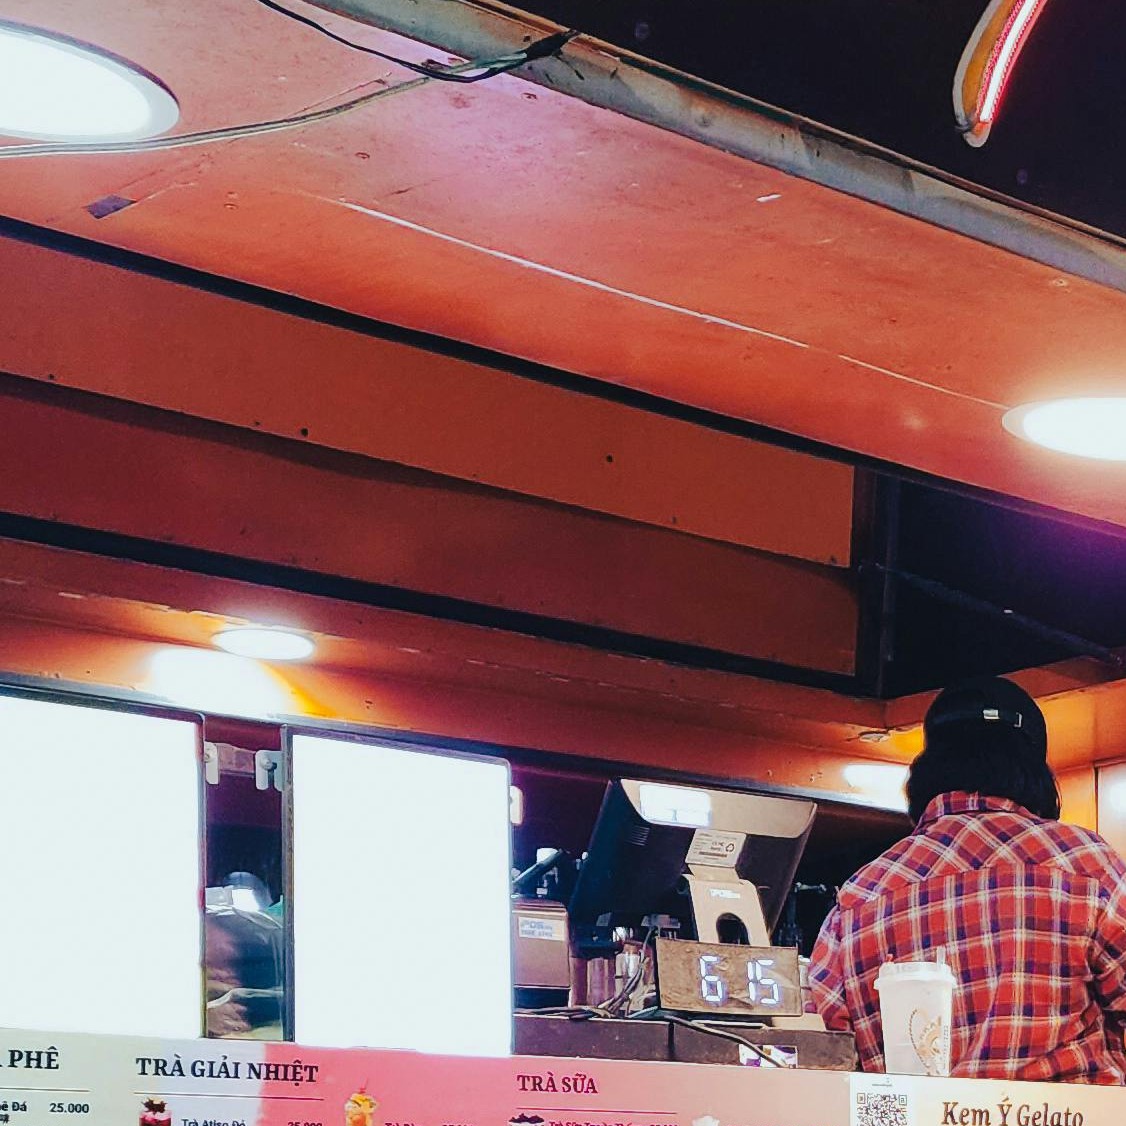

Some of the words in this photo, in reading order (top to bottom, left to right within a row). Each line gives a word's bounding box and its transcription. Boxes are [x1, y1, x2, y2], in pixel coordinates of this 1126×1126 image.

[8, 1046, 60, 1069] PHÊ
[136, 1053, 186, 1076] TRÀ
[190, 1055, 241, 1079] GIẢI
[247, 1059, 319, 1086] NHIỆT
[517, 1071, 558, 1092] TRÀ
[561, 1073, 598, 1093] SỮA
[12, 1101, 27, 1112] Đá
[49, 1103, 89, 1113] 25.000
[941, 1102, 991, 1126] Kem
[997, 1097, 1013, 1126] Ý
